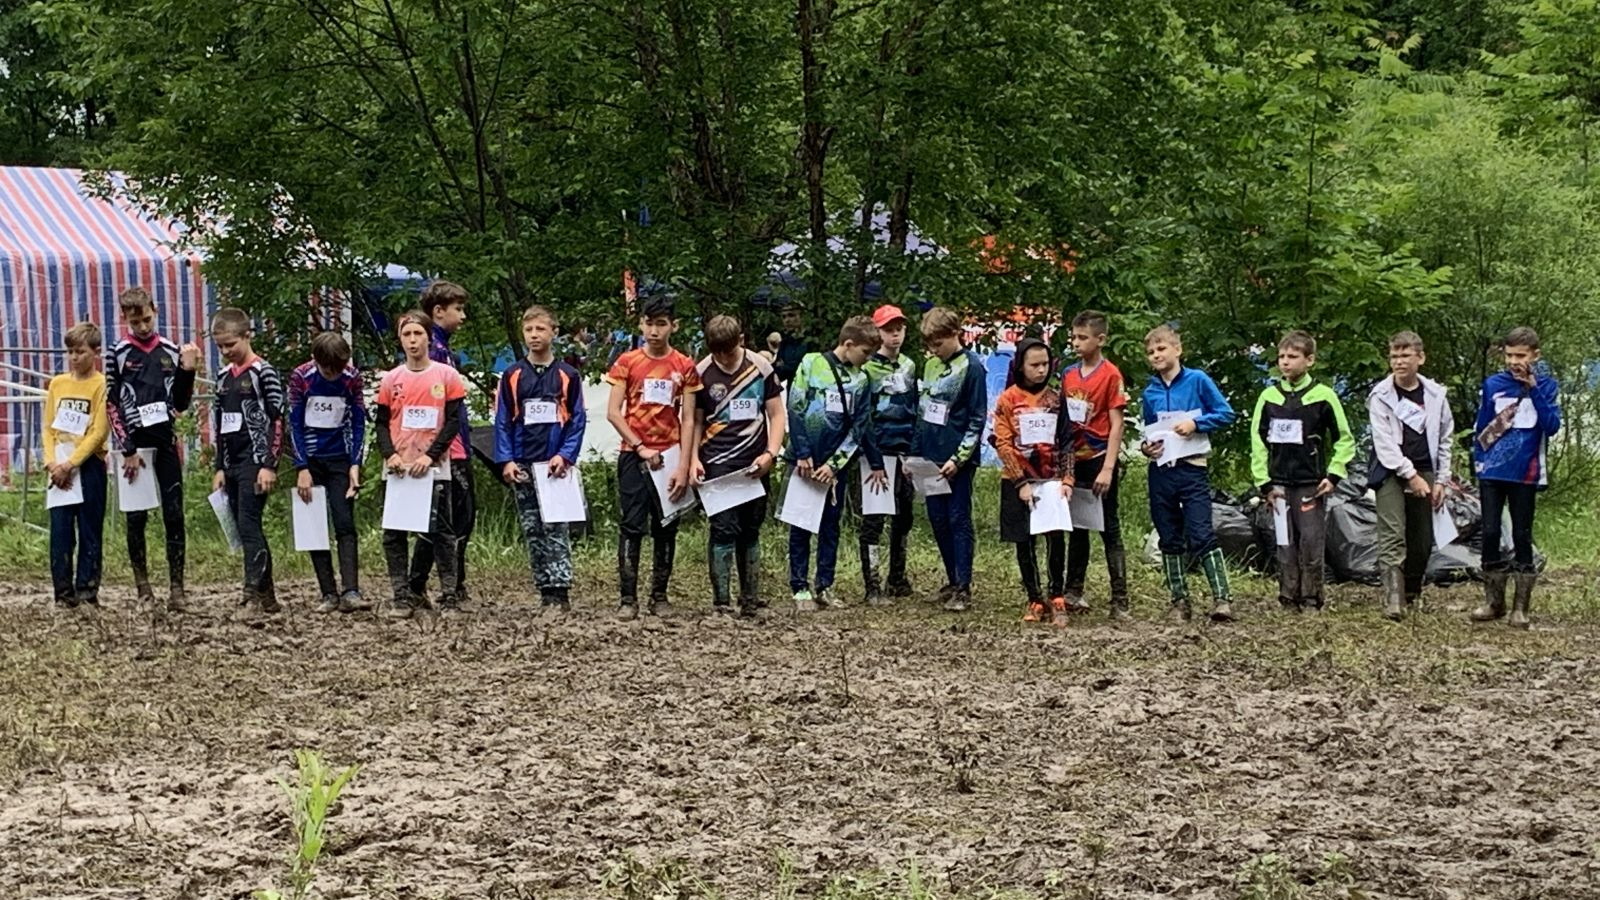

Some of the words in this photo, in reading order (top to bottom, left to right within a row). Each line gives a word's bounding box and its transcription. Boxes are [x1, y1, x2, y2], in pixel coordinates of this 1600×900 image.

[648, 380, 666, 389] 558
[314, 403, 333, 412] 554
[530, 405, 549, 414] 557
[733, 400, 752, 410] 559
[142, 404, 162, 416] 552
[407, 409, 426, 418] 555
[64, 412, 81, 424] 551
[224, 414, 236, 424] 553
